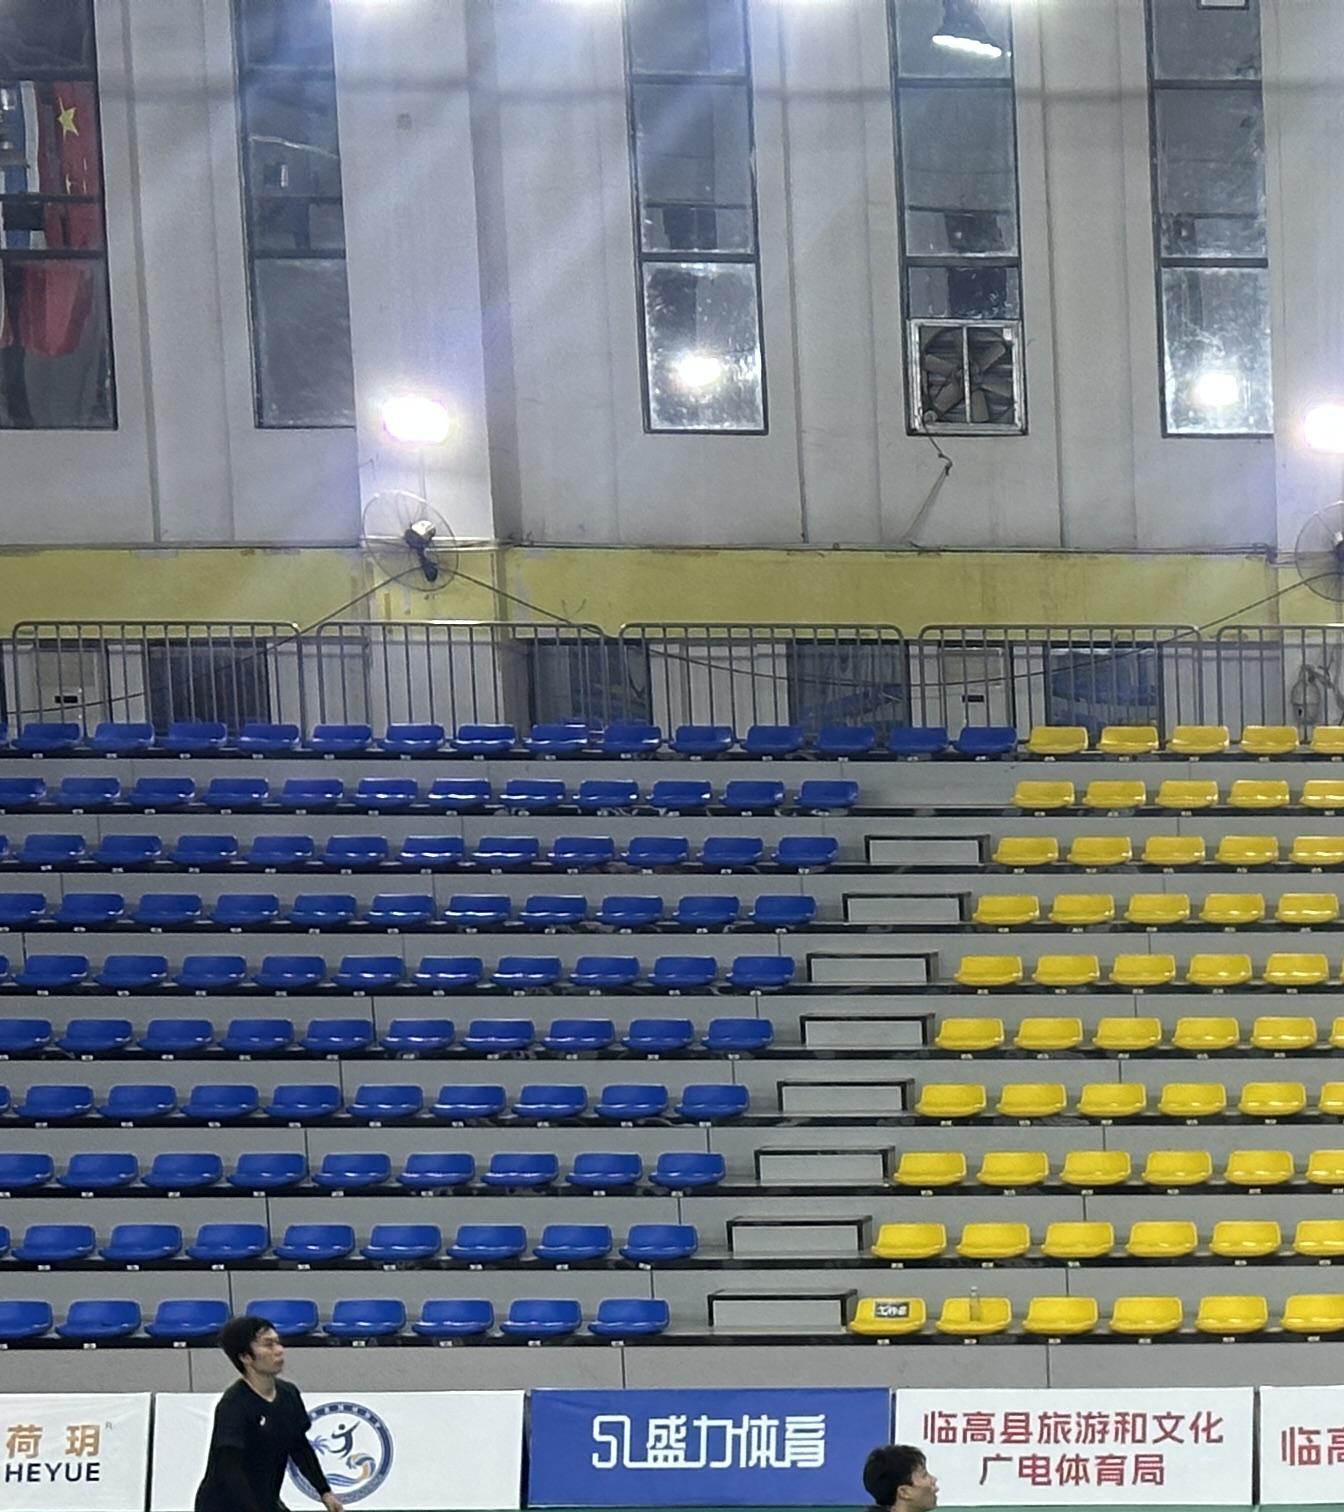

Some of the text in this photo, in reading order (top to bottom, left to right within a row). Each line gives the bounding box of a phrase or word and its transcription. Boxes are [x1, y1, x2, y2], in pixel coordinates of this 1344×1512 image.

[922, 1410, 1225, 1446] 临高县旅游和文化
[5, 1462, 101, 1482] HEYUE
[979, 1453, 1166, 1488] 广电体育局
